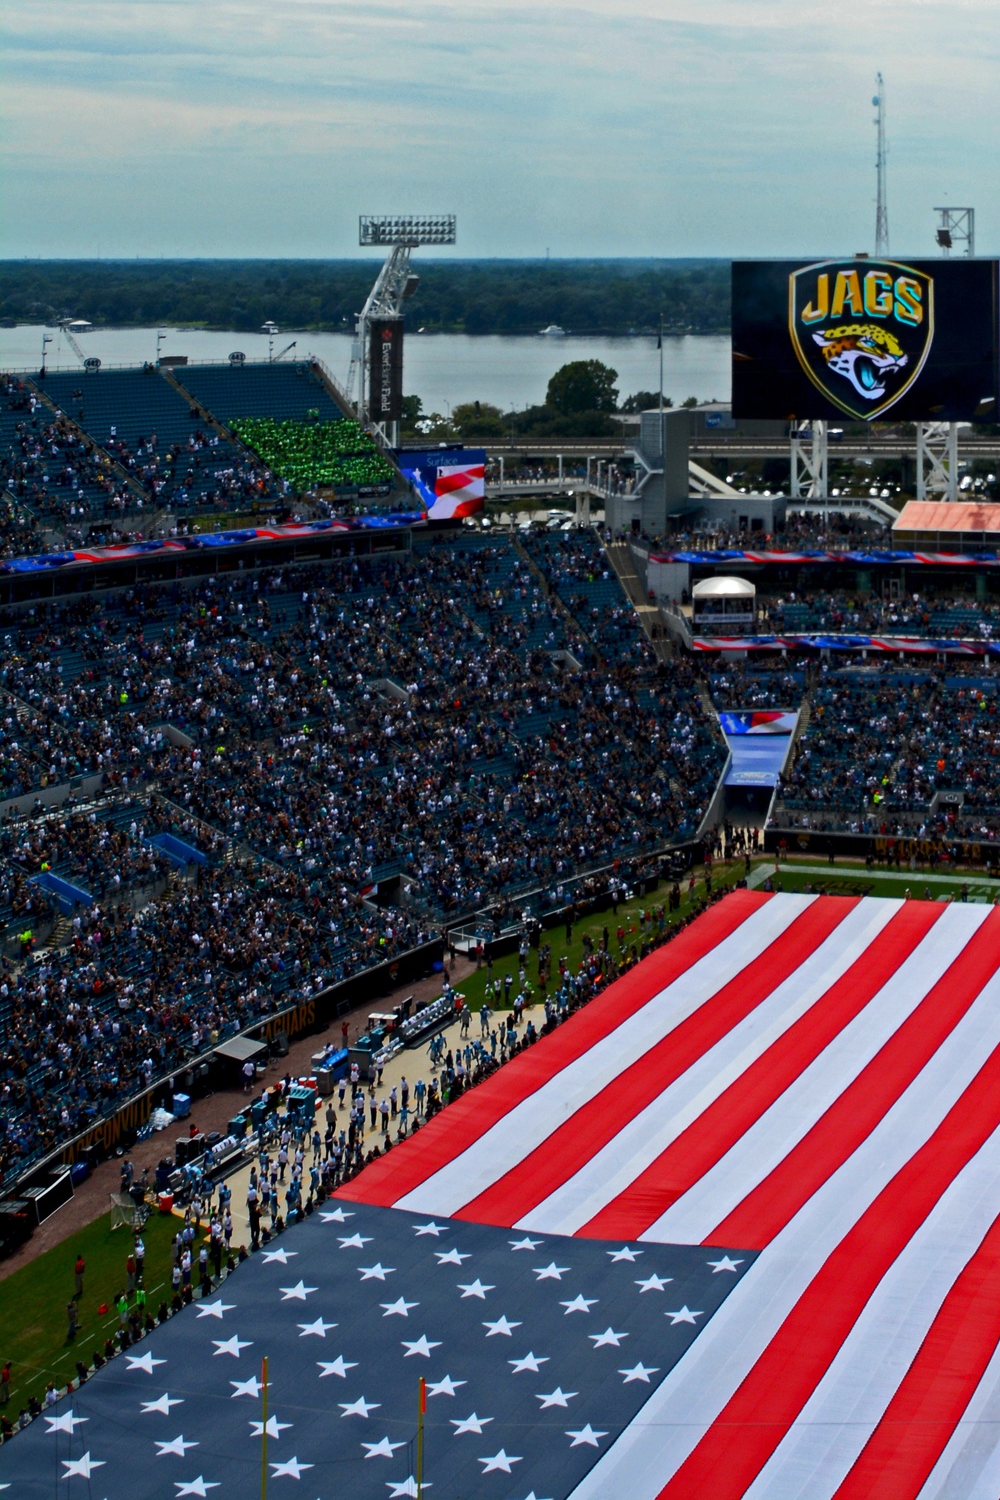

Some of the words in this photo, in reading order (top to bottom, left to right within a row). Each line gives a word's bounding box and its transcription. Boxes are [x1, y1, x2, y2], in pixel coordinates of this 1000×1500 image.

[801, 270, 923, 327] JAGS
[381, 342, 391, 388] EverBank
[381, 388, 391, 411] Field
[427, 456, 458, 467] Surface
[260, 1000, 316, 1040] AGUARS
